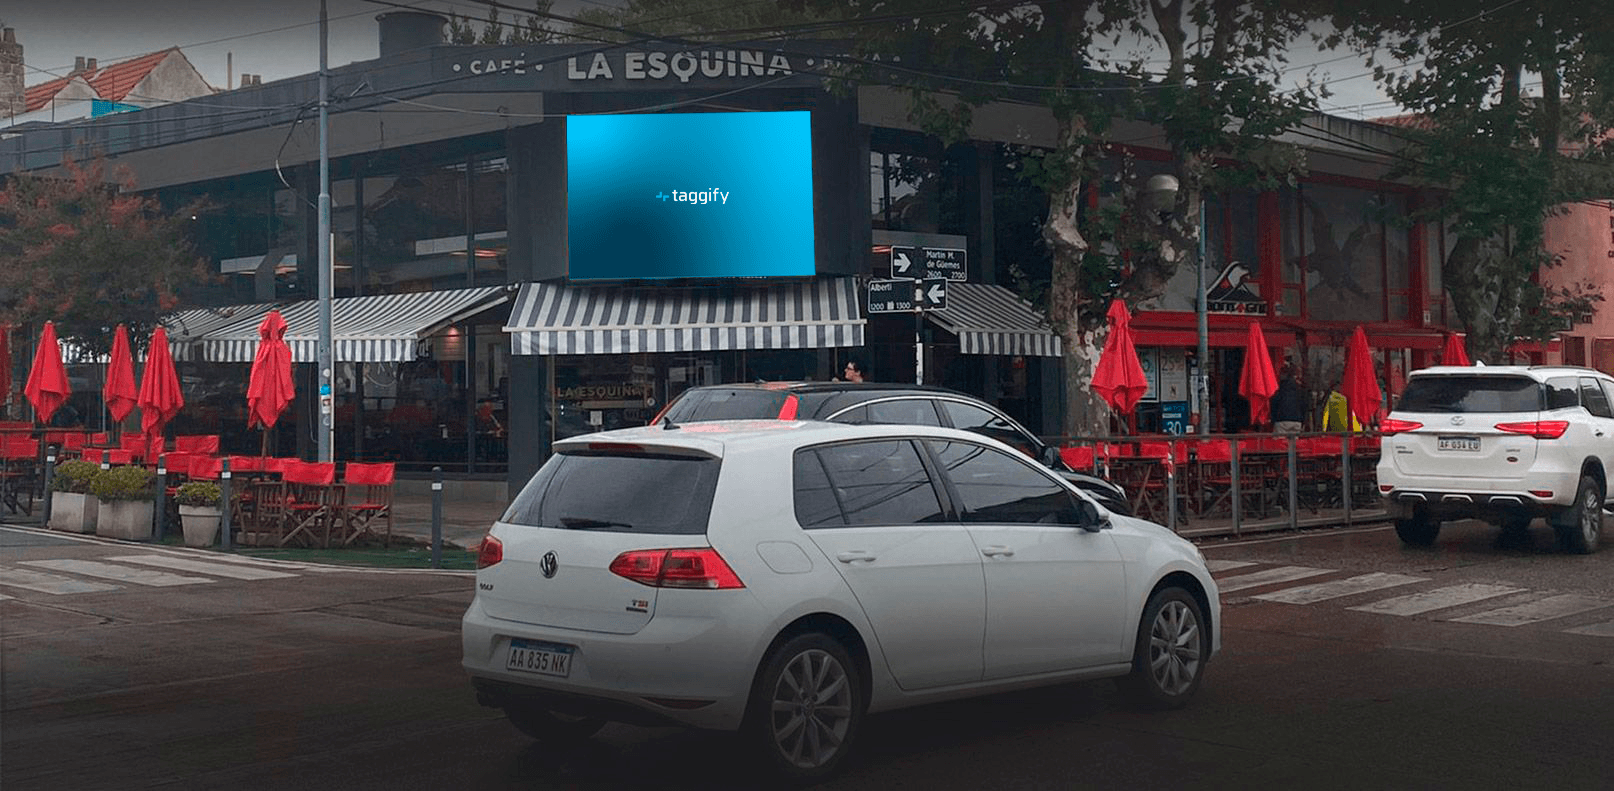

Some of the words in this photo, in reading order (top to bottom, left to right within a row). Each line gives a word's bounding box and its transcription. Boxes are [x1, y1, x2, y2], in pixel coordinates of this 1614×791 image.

[568, 52, 613, 80] LA
[625, 49, 793, 83] ESQUINA
[671, 187, 730, 205] taggify
[926, 260, 936, 269] de
[951, 271, 966, 279] 2700
[870, 283, 892, 291] Alberti
[870, 303, 885, 311] 1200
[896, 302, 911, 310] 1300
[509, 649, 524, 668] AA
[527, 651, 549, 671] 835
[551, 654, 568, 674] NK
